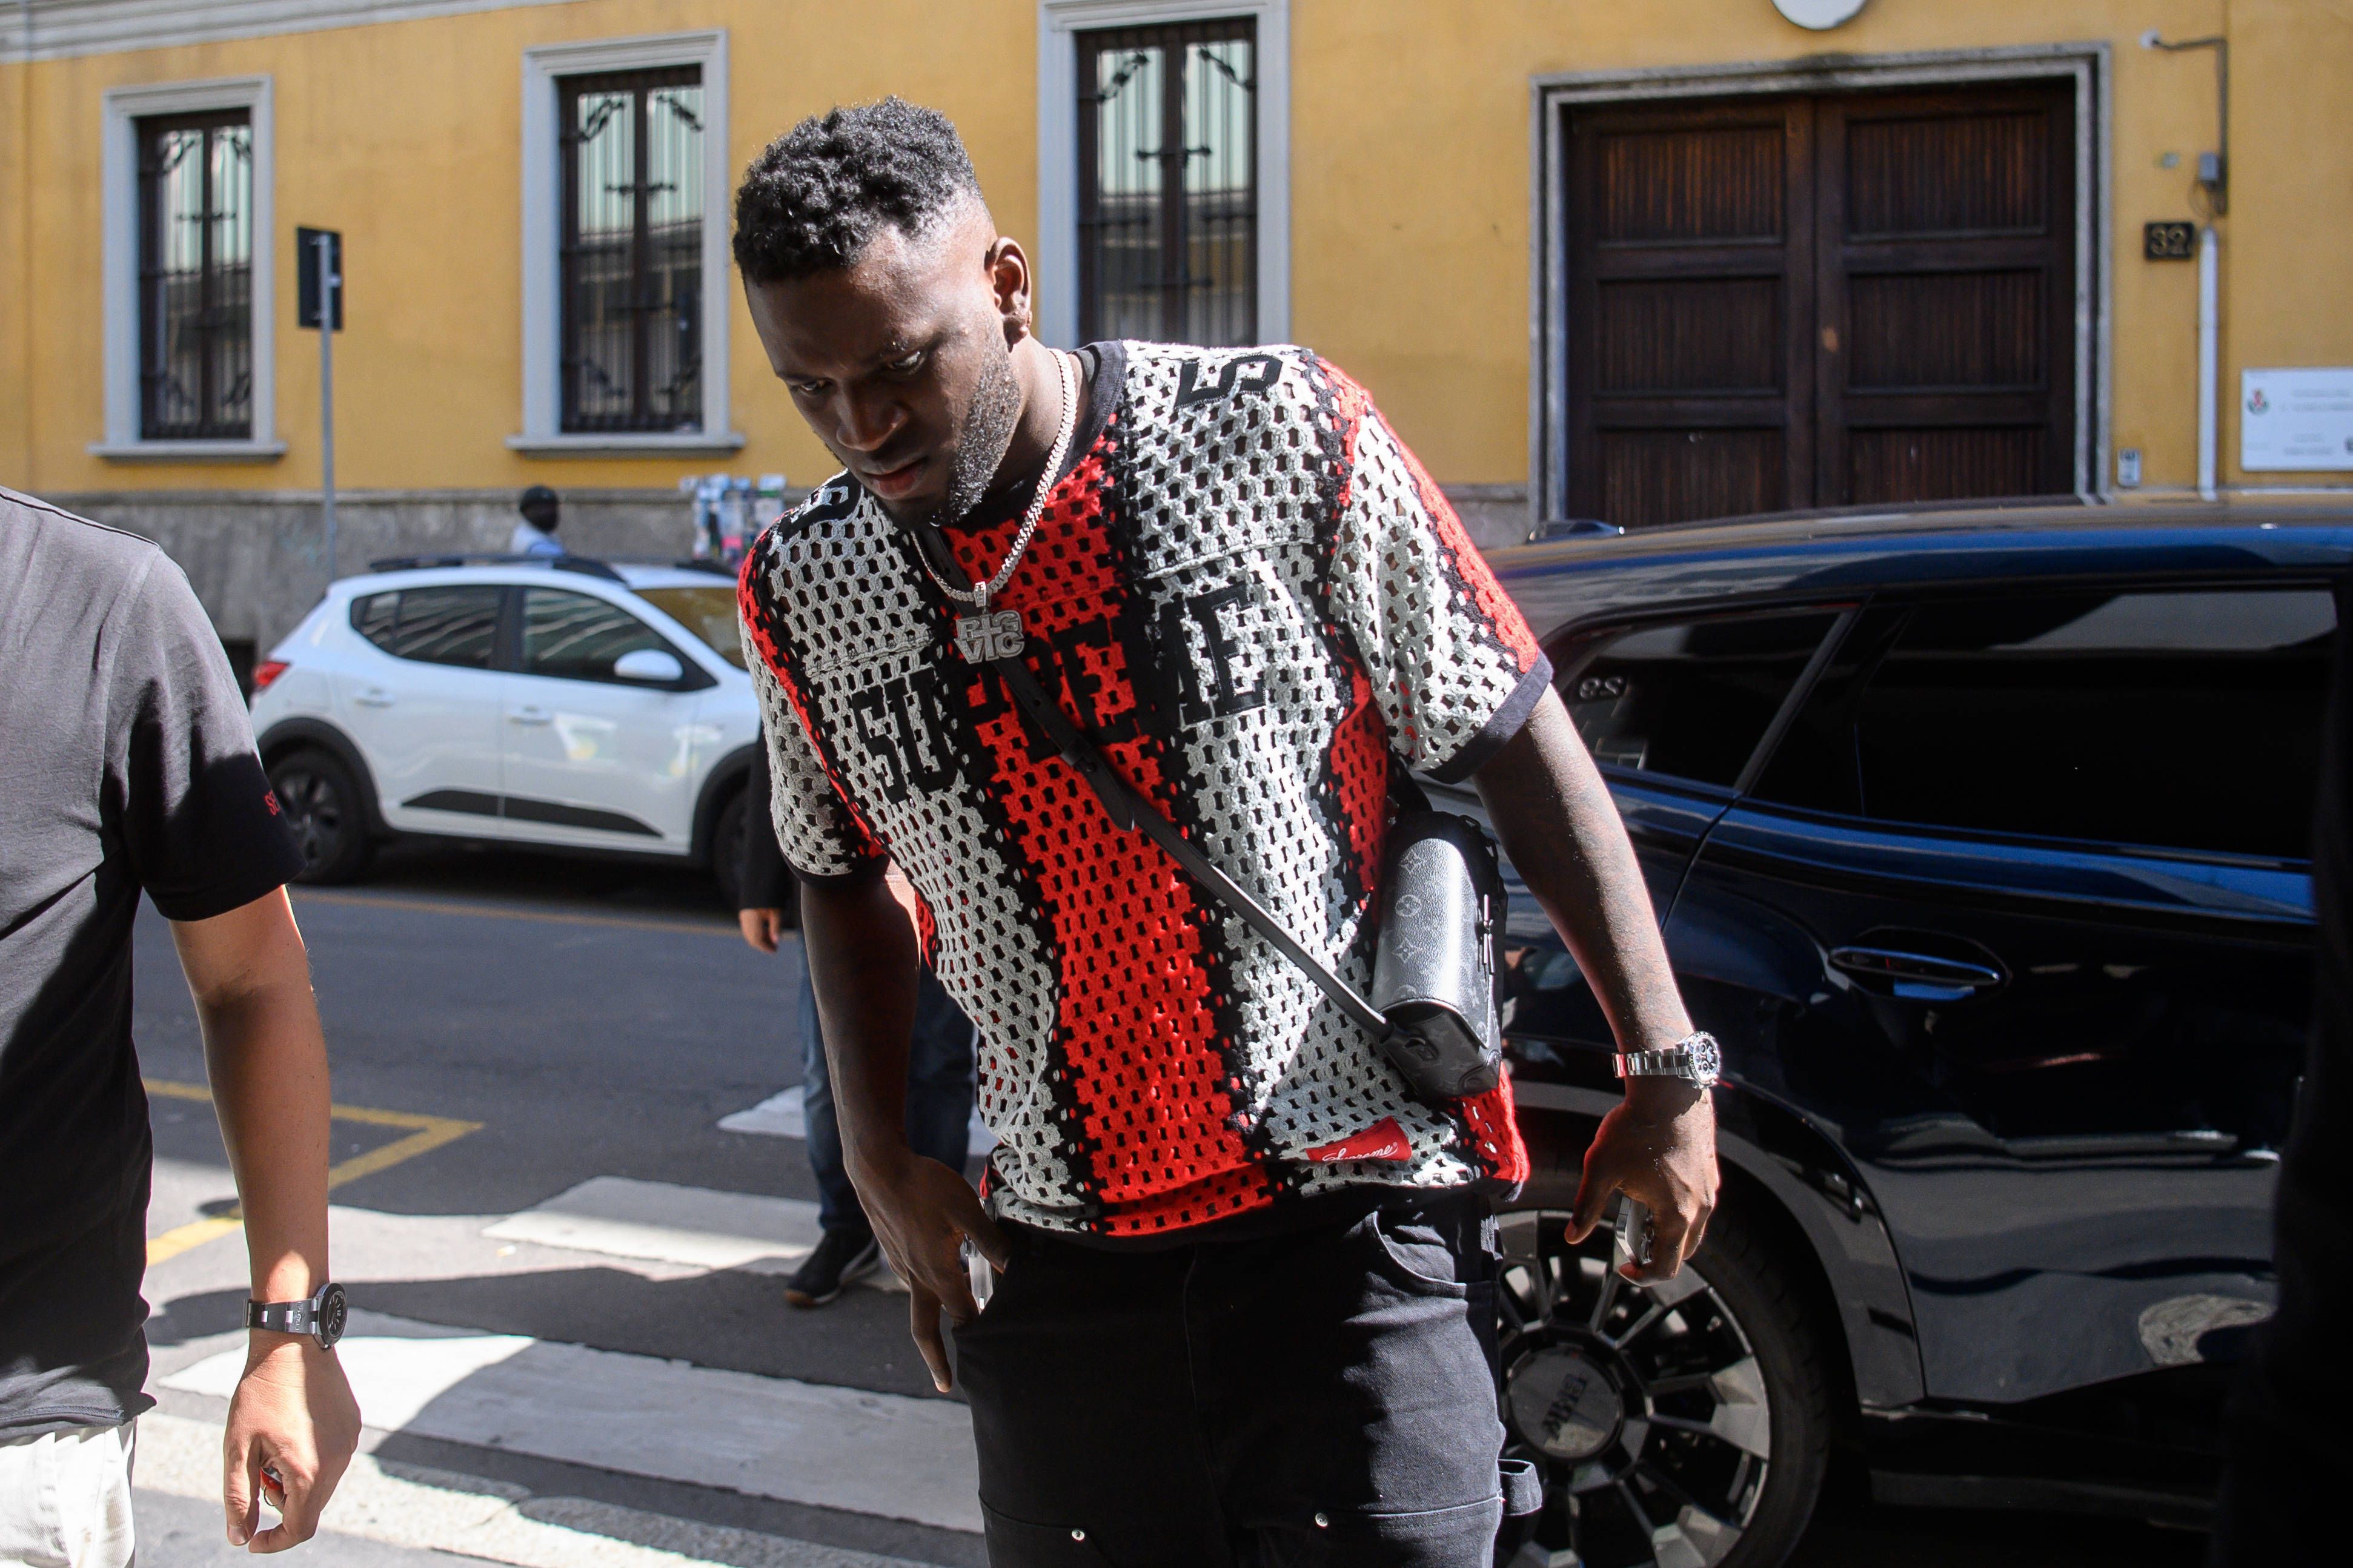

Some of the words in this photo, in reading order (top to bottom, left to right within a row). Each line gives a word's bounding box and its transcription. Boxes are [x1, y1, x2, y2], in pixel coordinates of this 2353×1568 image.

[2151, 225, 2187, 255] 32
[954, 632, 1025, 664] VIC
[1322, 1144, 1398, 1161] Sreme
